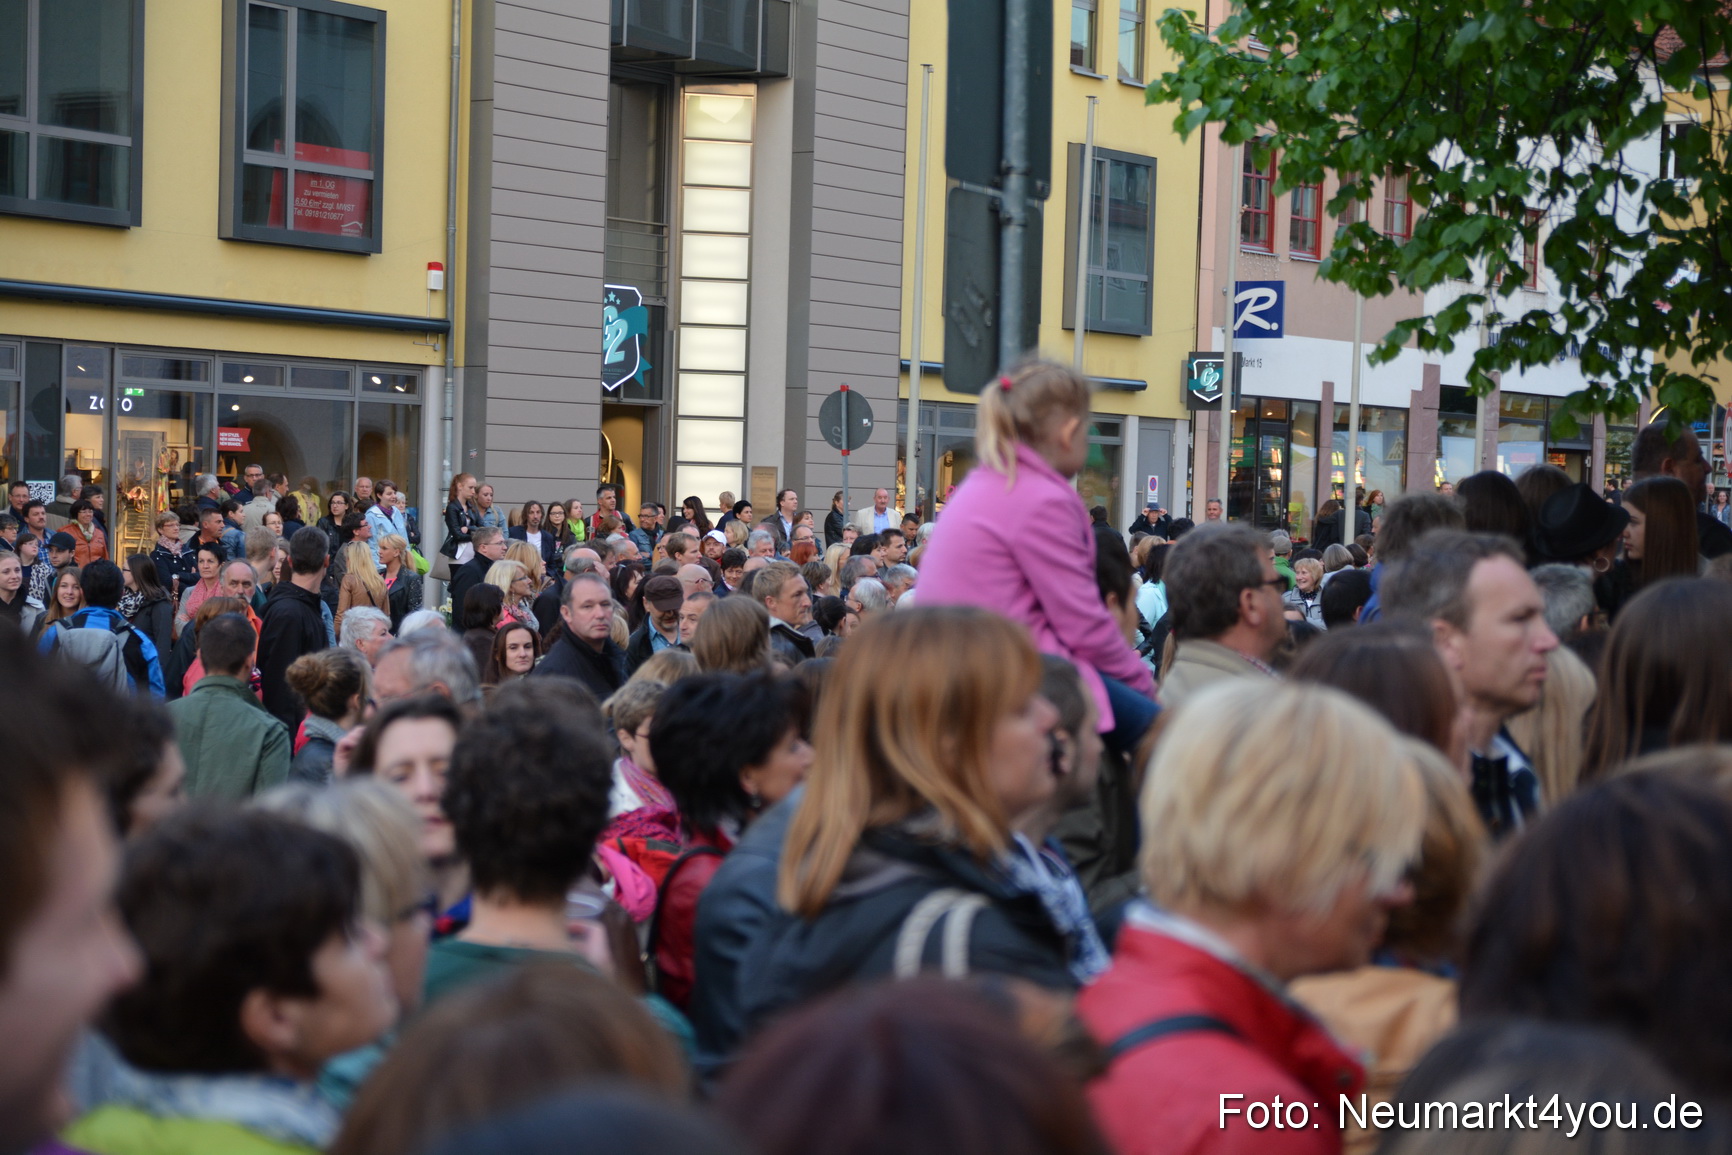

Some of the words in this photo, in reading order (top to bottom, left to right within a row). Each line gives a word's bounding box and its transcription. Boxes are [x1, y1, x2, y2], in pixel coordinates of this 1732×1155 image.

[325, 181, 336, 189] OG
[312, 191, 339, 199] vermieten
[294, 208, 304, 216] Tel.
[1257, 358, 1263, 368] 15
